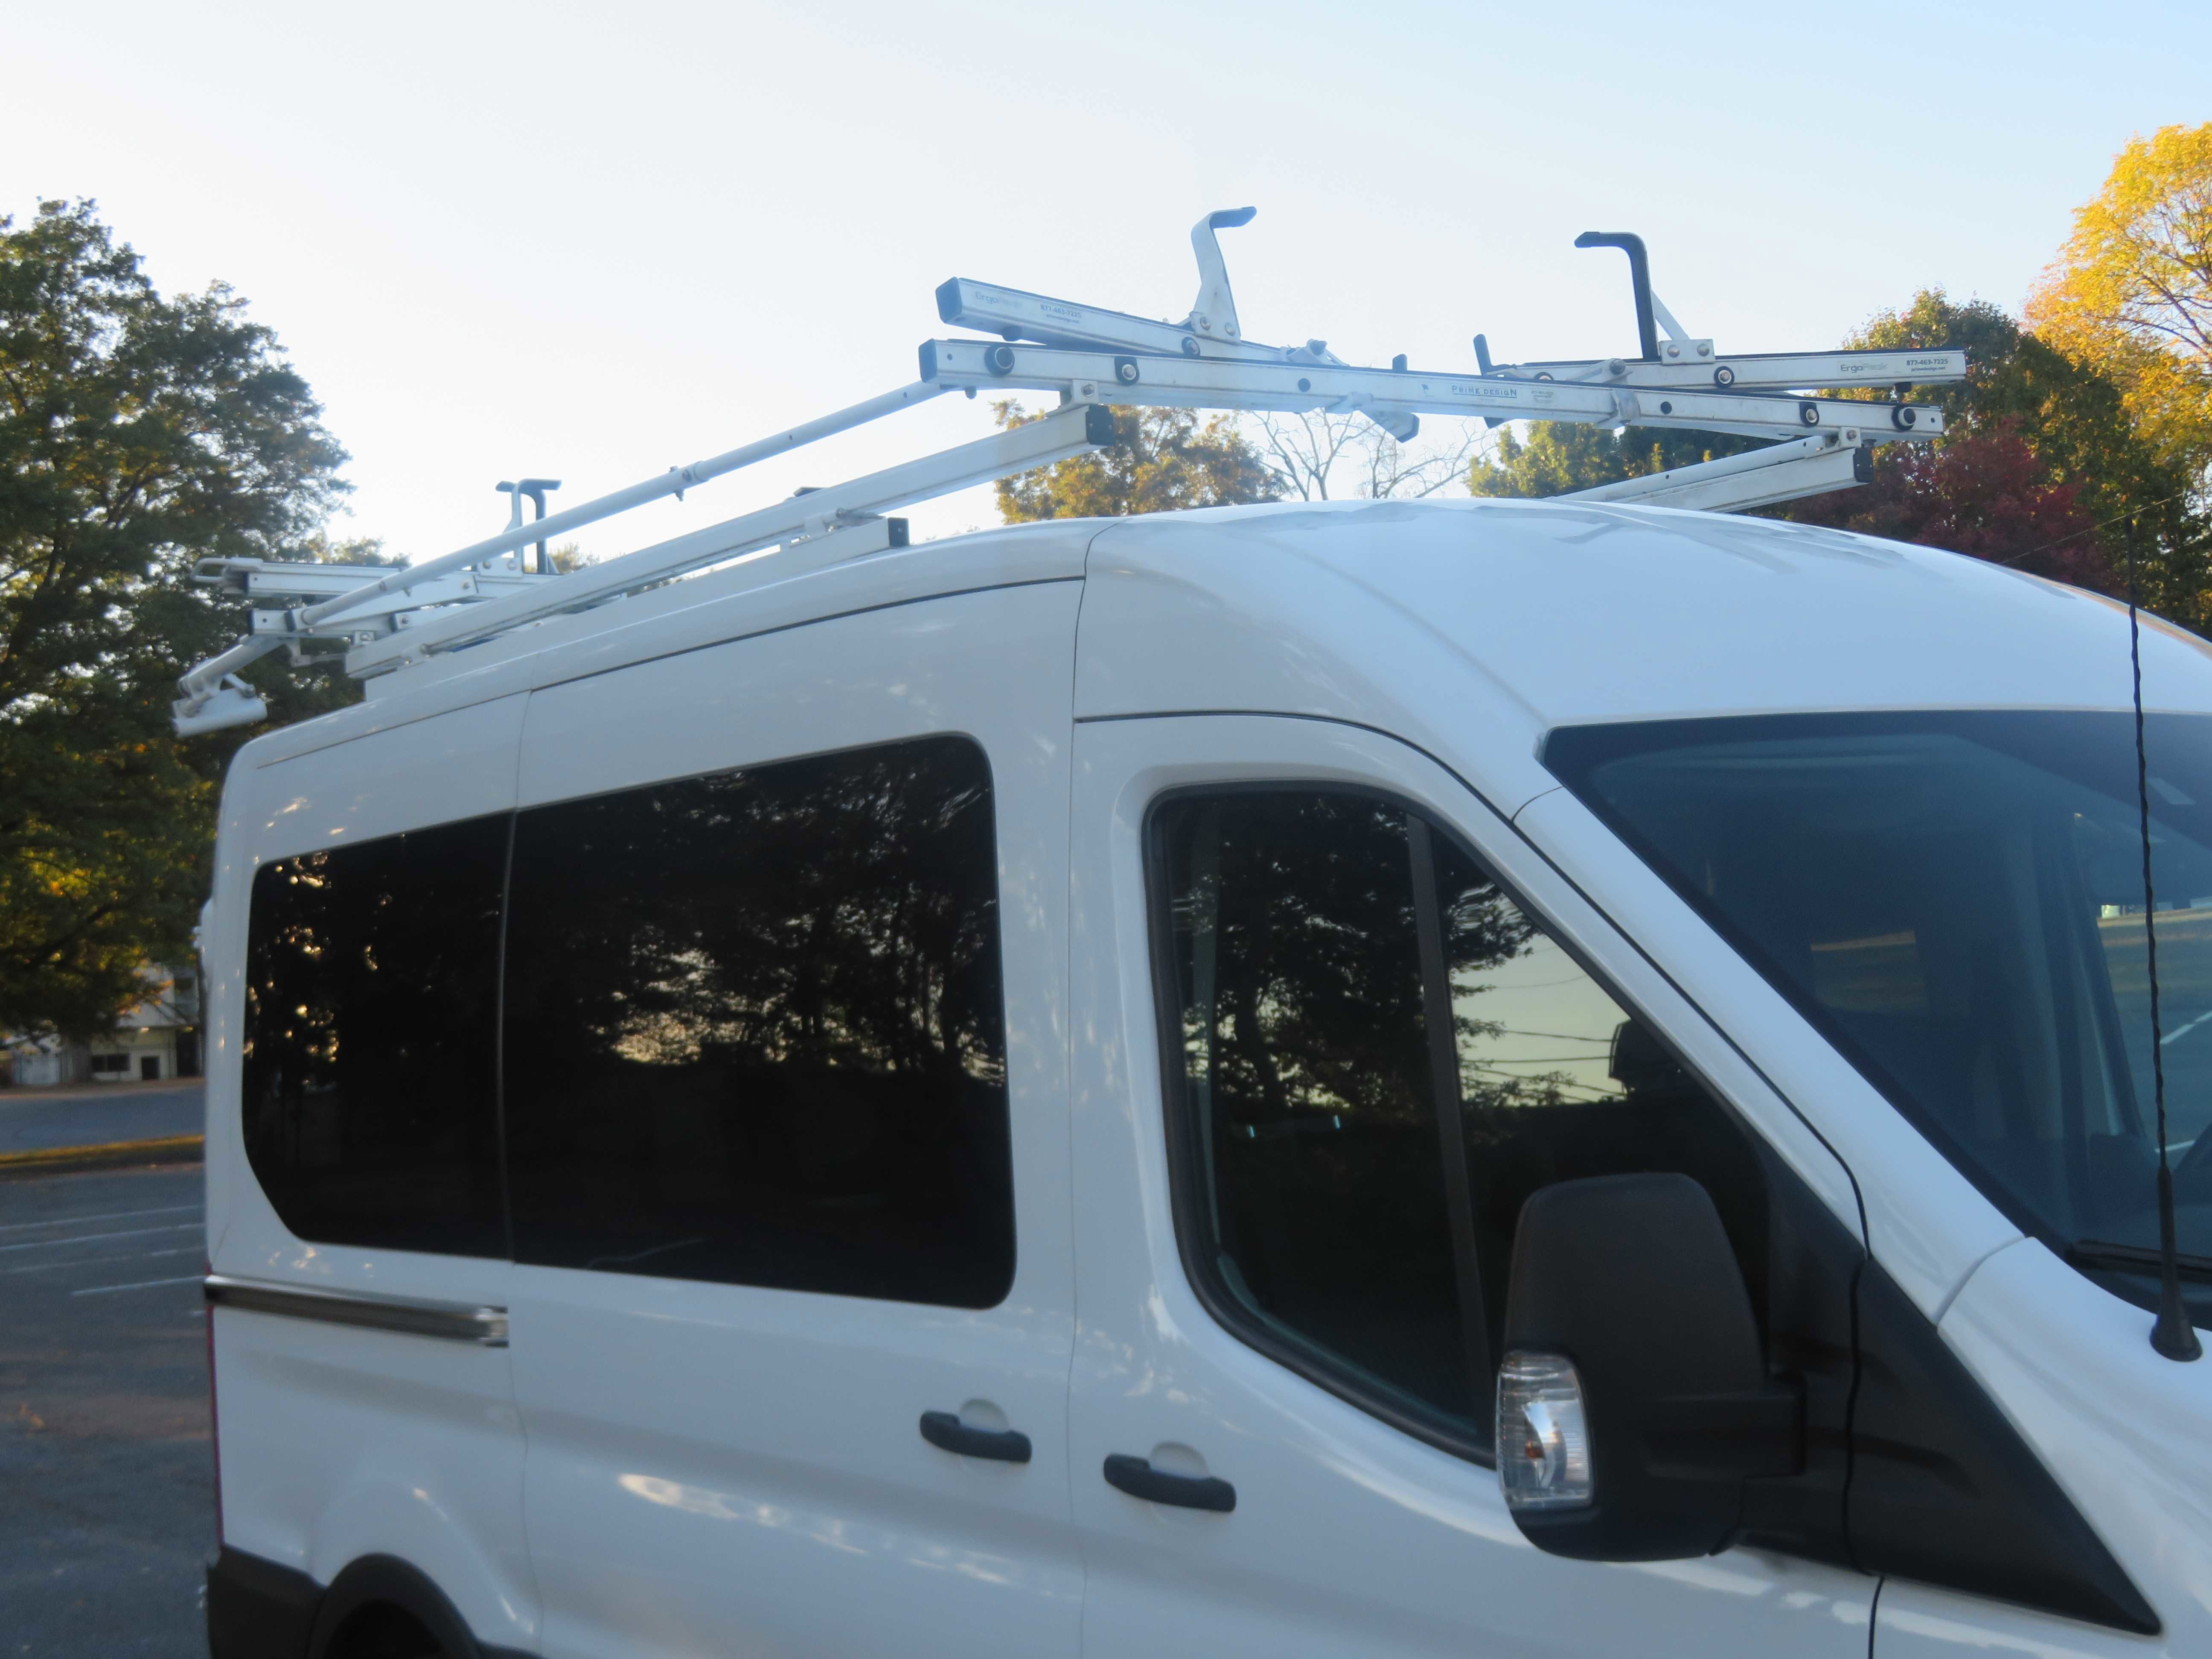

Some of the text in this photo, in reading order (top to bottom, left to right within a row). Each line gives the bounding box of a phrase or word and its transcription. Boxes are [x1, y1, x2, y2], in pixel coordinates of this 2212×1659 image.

[1040, 303, 1082, 318] 877-463-7225
[1452, 385, 1517, 396] PRIME DESIGN
